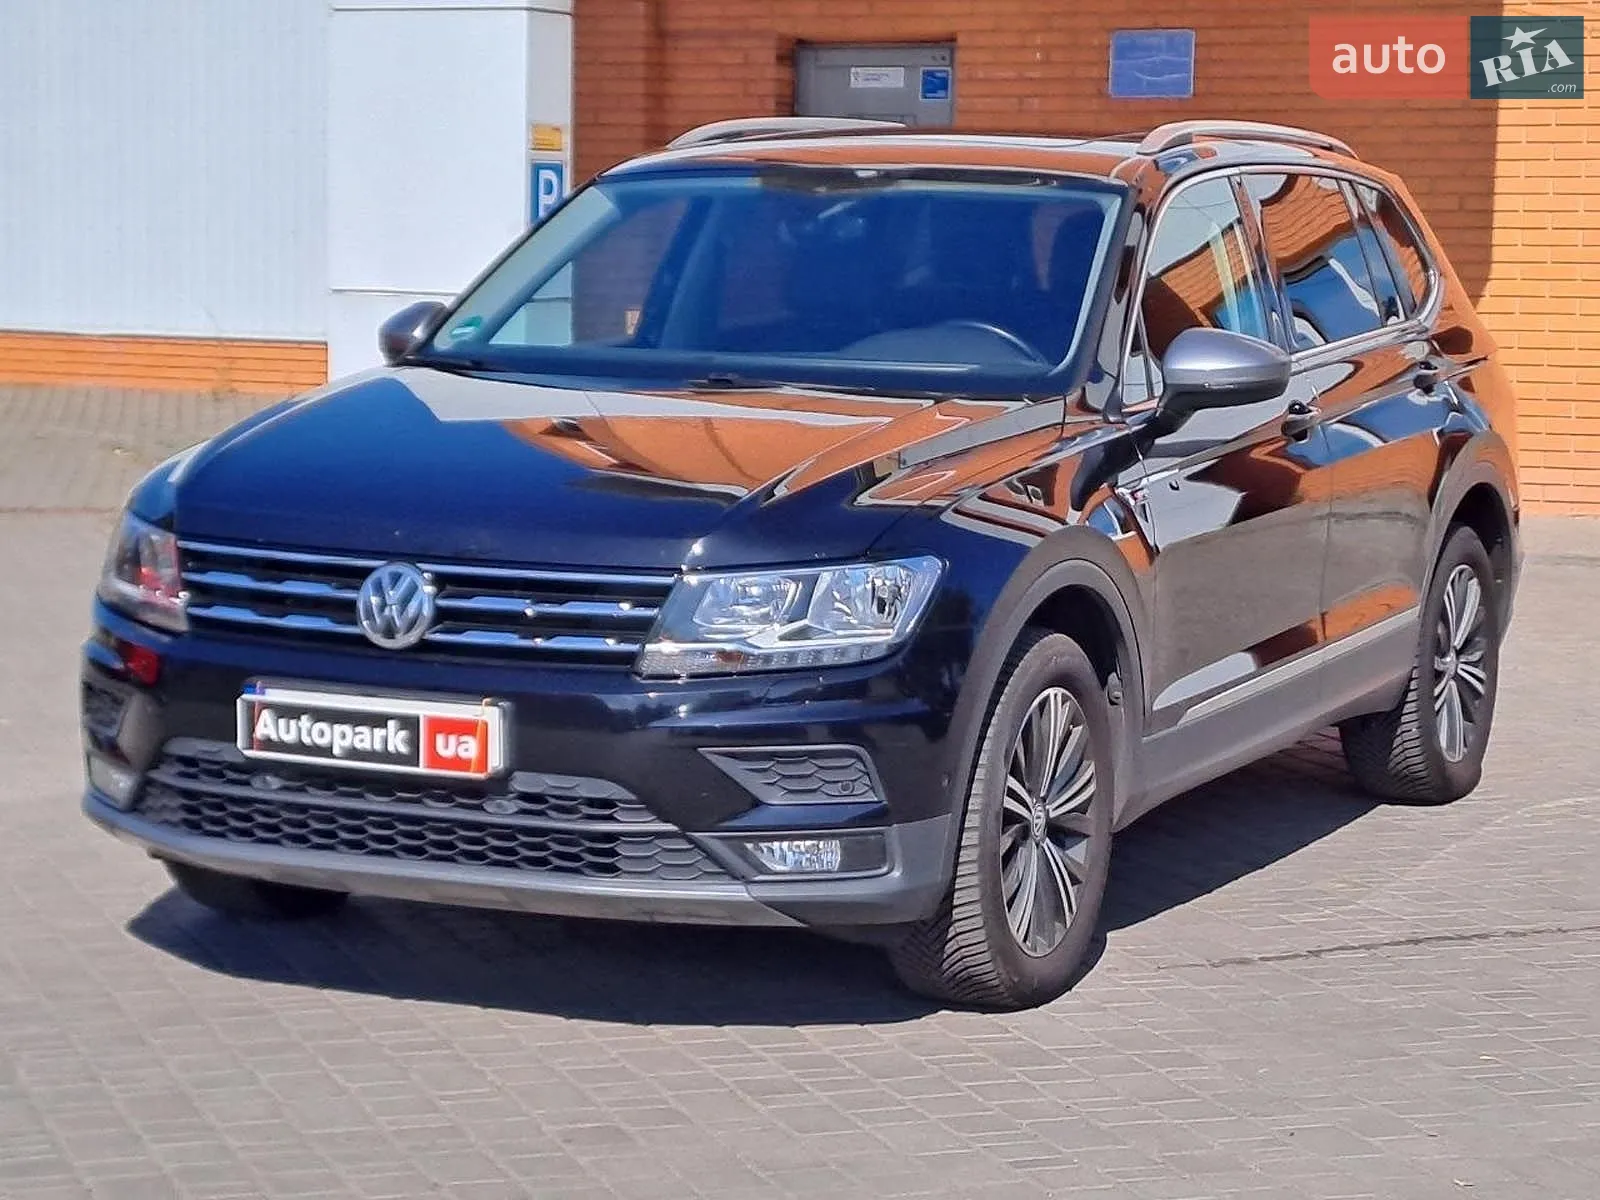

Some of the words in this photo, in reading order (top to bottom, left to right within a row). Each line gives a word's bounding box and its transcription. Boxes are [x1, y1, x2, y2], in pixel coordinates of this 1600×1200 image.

[538, 168, 558, 218] P
[254, 708, 410, 757] Autopark
[434, 732, 478, 760] ua
